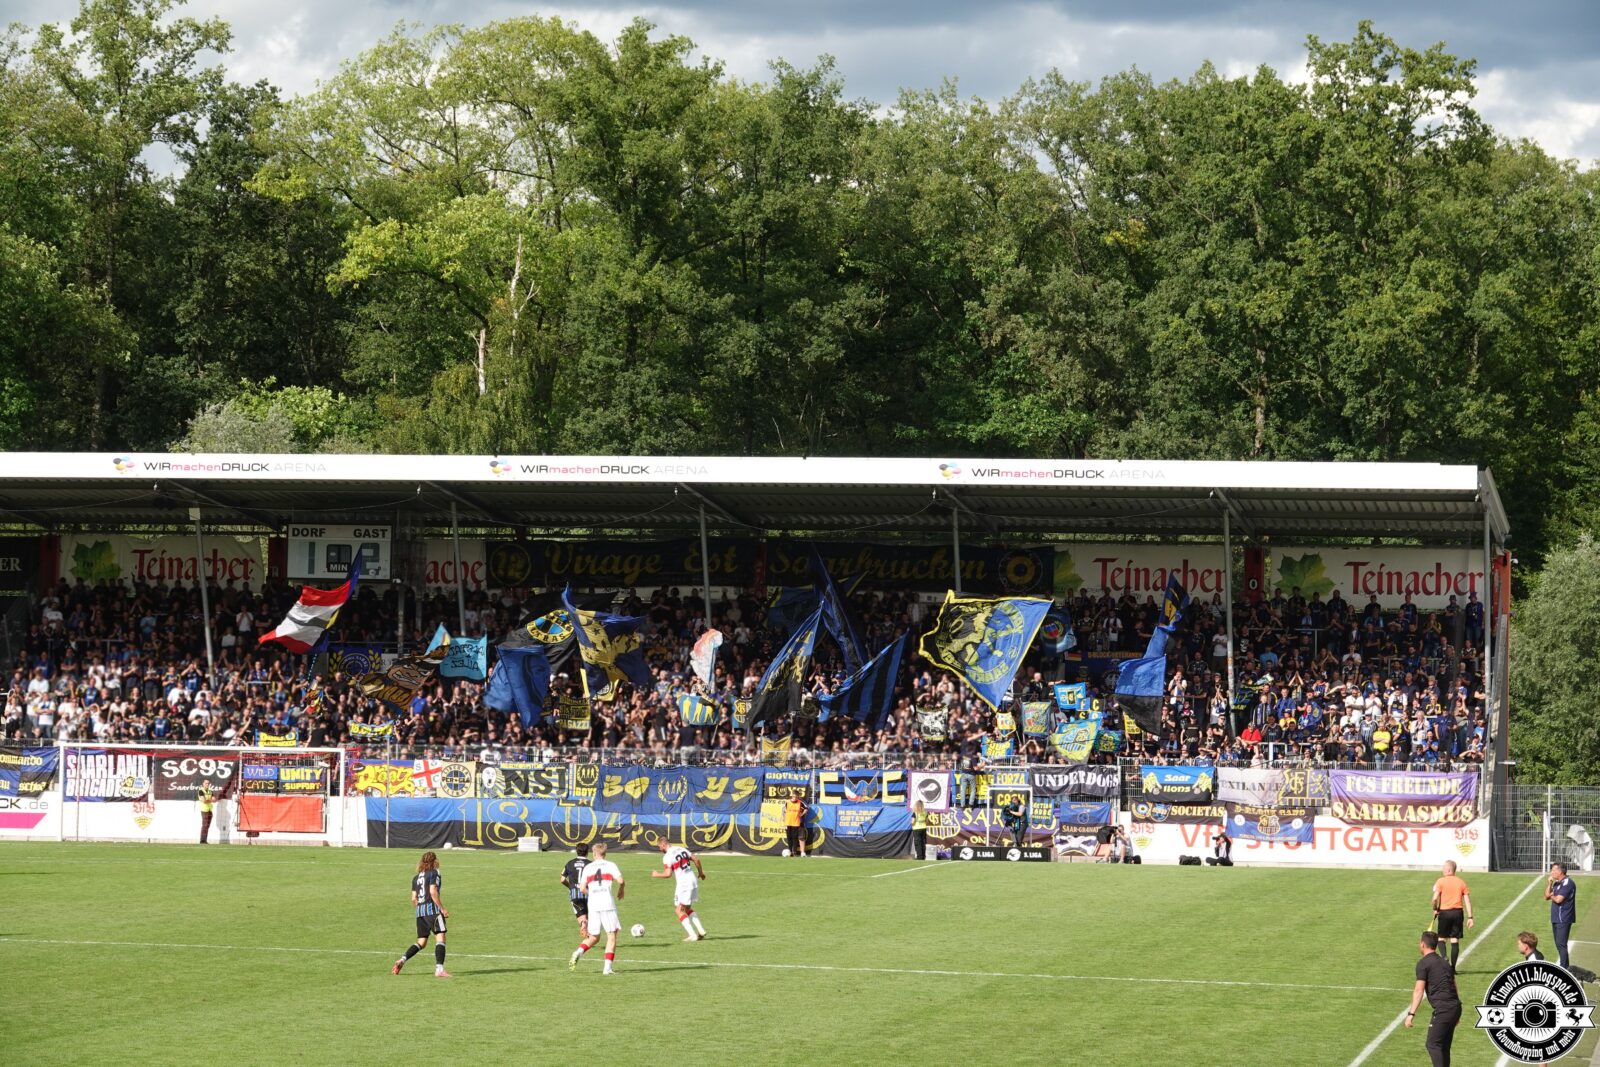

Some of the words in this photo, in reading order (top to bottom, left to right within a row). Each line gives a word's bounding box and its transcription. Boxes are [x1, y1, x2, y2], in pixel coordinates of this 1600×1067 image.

[144, 461, 270, 472] WIRmachenDRUCK
[520, 464, 650, 475] WIRmachenDRUCK
[971, 468, 1105, 479] WIRmachenDRUCK
[291, 527, 326, 538] DORF
[352, 528, 388, 538] GAST
[328, 563, 348, 573] MIN
[66, 754, 148, 779] SAARLAND
[161, 758, 234, 779] SC95
[279, 766, 323, 781] UNITY
[1033, 770, 1119, 788] UNDERDOGS
[1164, 774, 1191, 782] Saar
[1345, 775, 1378, 793] FCS
[1381, 777, 1463, 795] FREUNDE
[1171, 805, 1225, 817] SOCIETAS
[1332, 801, 1474, 823] SAARKASMUS
[594, 868, 603, 887] 4
